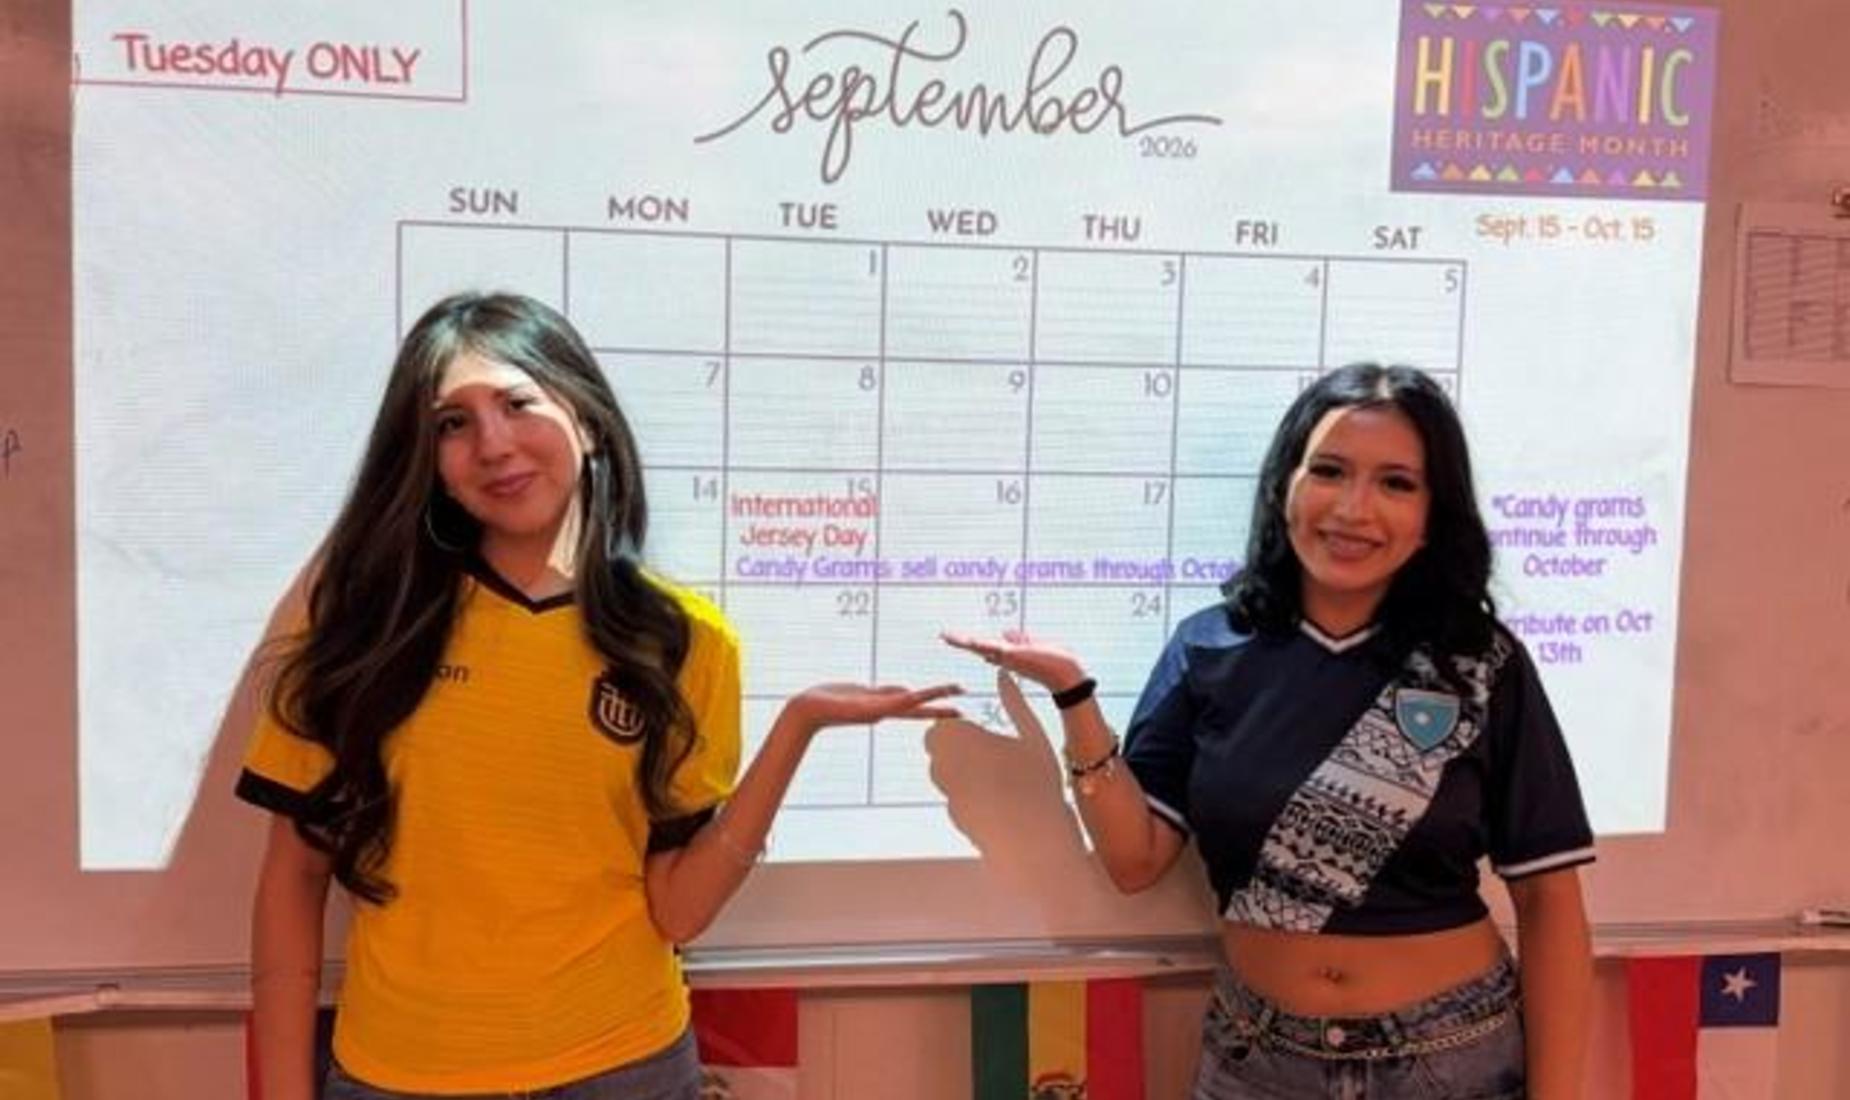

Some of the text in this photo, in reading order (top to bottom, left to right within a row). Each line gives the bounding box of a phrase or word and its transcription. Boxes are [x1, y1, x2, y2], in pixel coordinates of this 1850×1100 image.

[114, 33, 421, 97] Tuesday ONLY
[1412, 35, 1694, 127] HISPANIC
[694, 10, 1222, 183] september
[1139, 136, 1198, 159] 2026
[1412, 129, 1689, 158] HERITAGE MONTH
[448, 187, 1422, 250] SUN MON TUE WED THU FRI SAT
[1538, 214, 1561, 239] 15
[1632, 216, 1655, 240] 15
[868, 249, 1459, 293] 1 2 3 4 5
[704, 362, 720, 387] 7
[858, 365, 877, 391] 8
[1008, 369, 1026, 394] 9
[1143, 372, 1172, 397] 10
[692, 477, 718, 501] 14
[996, 480, 1022, 504] 16
[1143, 480, 1167, 505] 17
[731, 493, 879, 518] International
[1574, 496, 1646, 528] grams
[739, 524, 868, 557] Jersey Day
[1486, 524, 1657, 554] ontinue through
[736, 556, 809, 585] Candy
[901, 555, 937, 578] sell
[944, 556, 1008, 585] candy
[1013, 560, 1084, 585] grams
[1093, 557, 1176, 585] through
[1523, 553, 1606, 578] October
[837, 591, 870, 616] 22
[984, 592, 1019, 617] 23
[1131, 592, 1162, 617] 24
[1583, 614, 1609, 635] on
[1615, 609, 1653, 634] Oct
[1538, 640, 1583, 663] 13th
